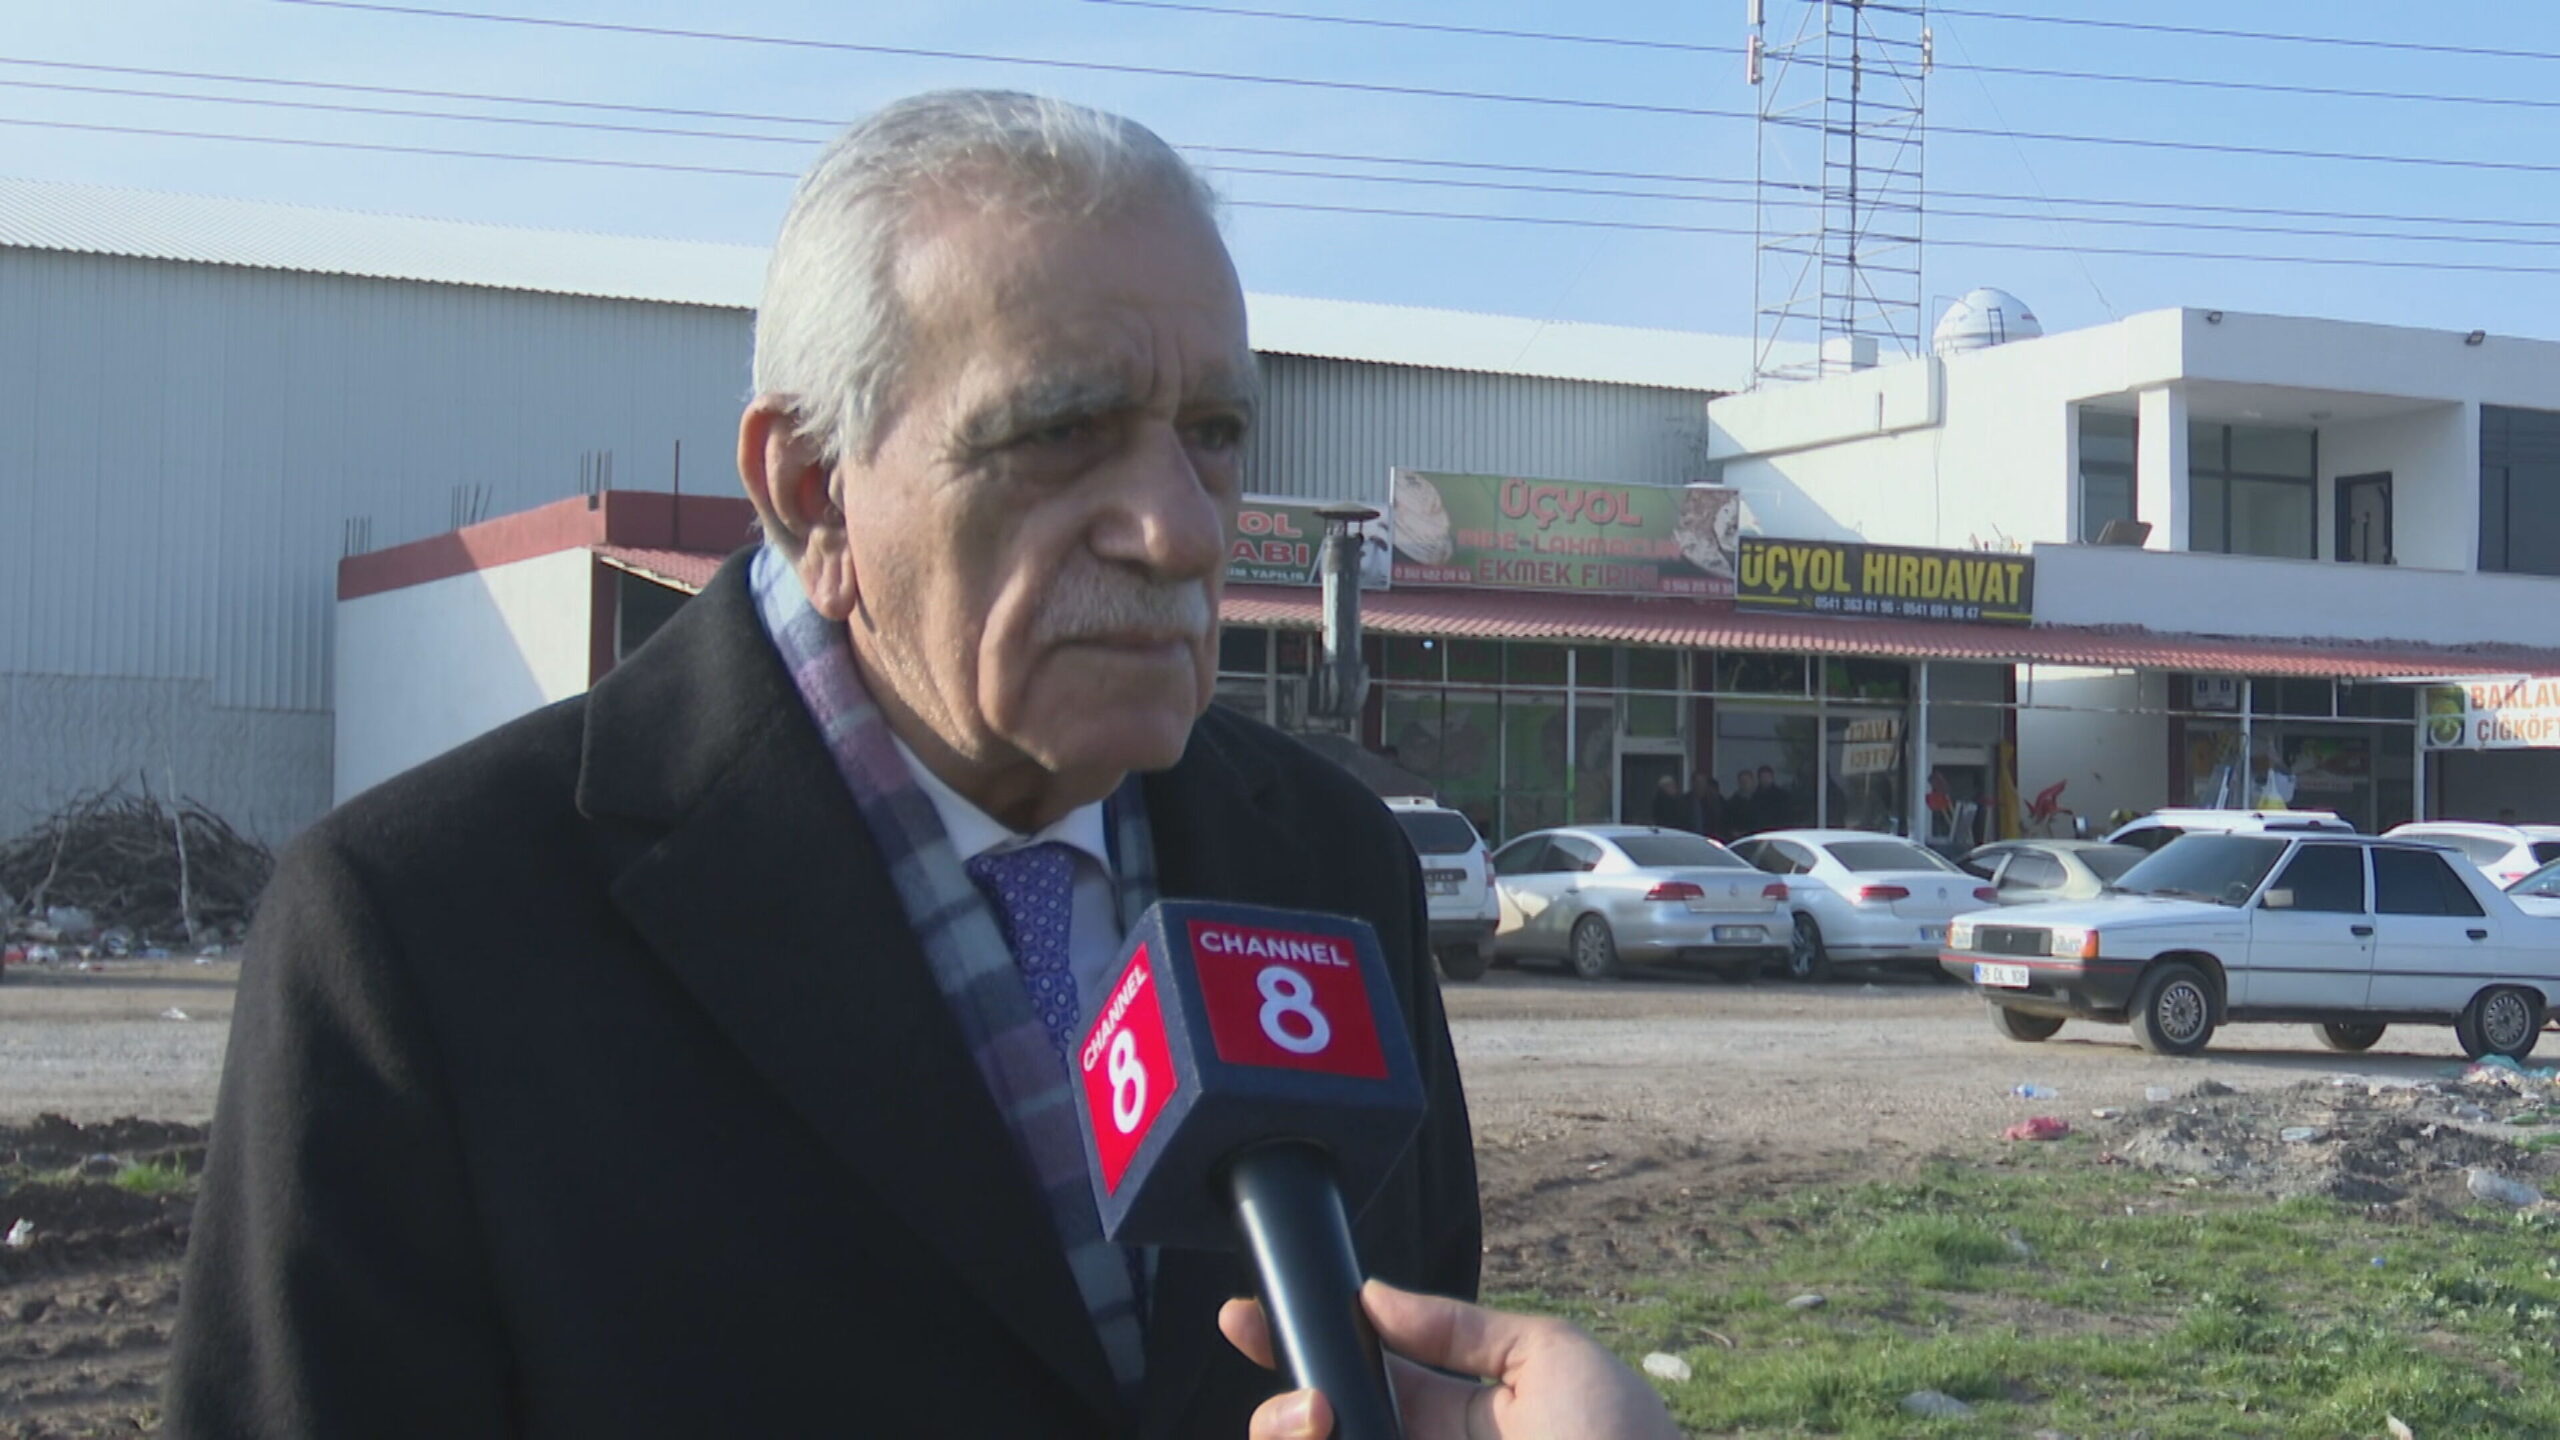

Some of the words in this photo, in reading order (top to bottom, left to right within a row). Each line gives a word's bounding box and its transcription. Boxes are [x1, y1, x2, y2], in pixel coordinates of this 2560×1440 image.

[1501, 478, 1643, 530] ÜÇYOL
[1479, 559, 1571, 584] EKMEK
[1741, 544, 1851, 593] ÜÇYOL
[1863, 553, 2024, 604] HIRDAVAT
[1200, 931, 1350, 968] CHANNEL
[1083, 965, 1149, 1072] CHANNEL
[1256, 965, 1331, 1054] 8
[1108, 1028, 1147, 1134] 8
